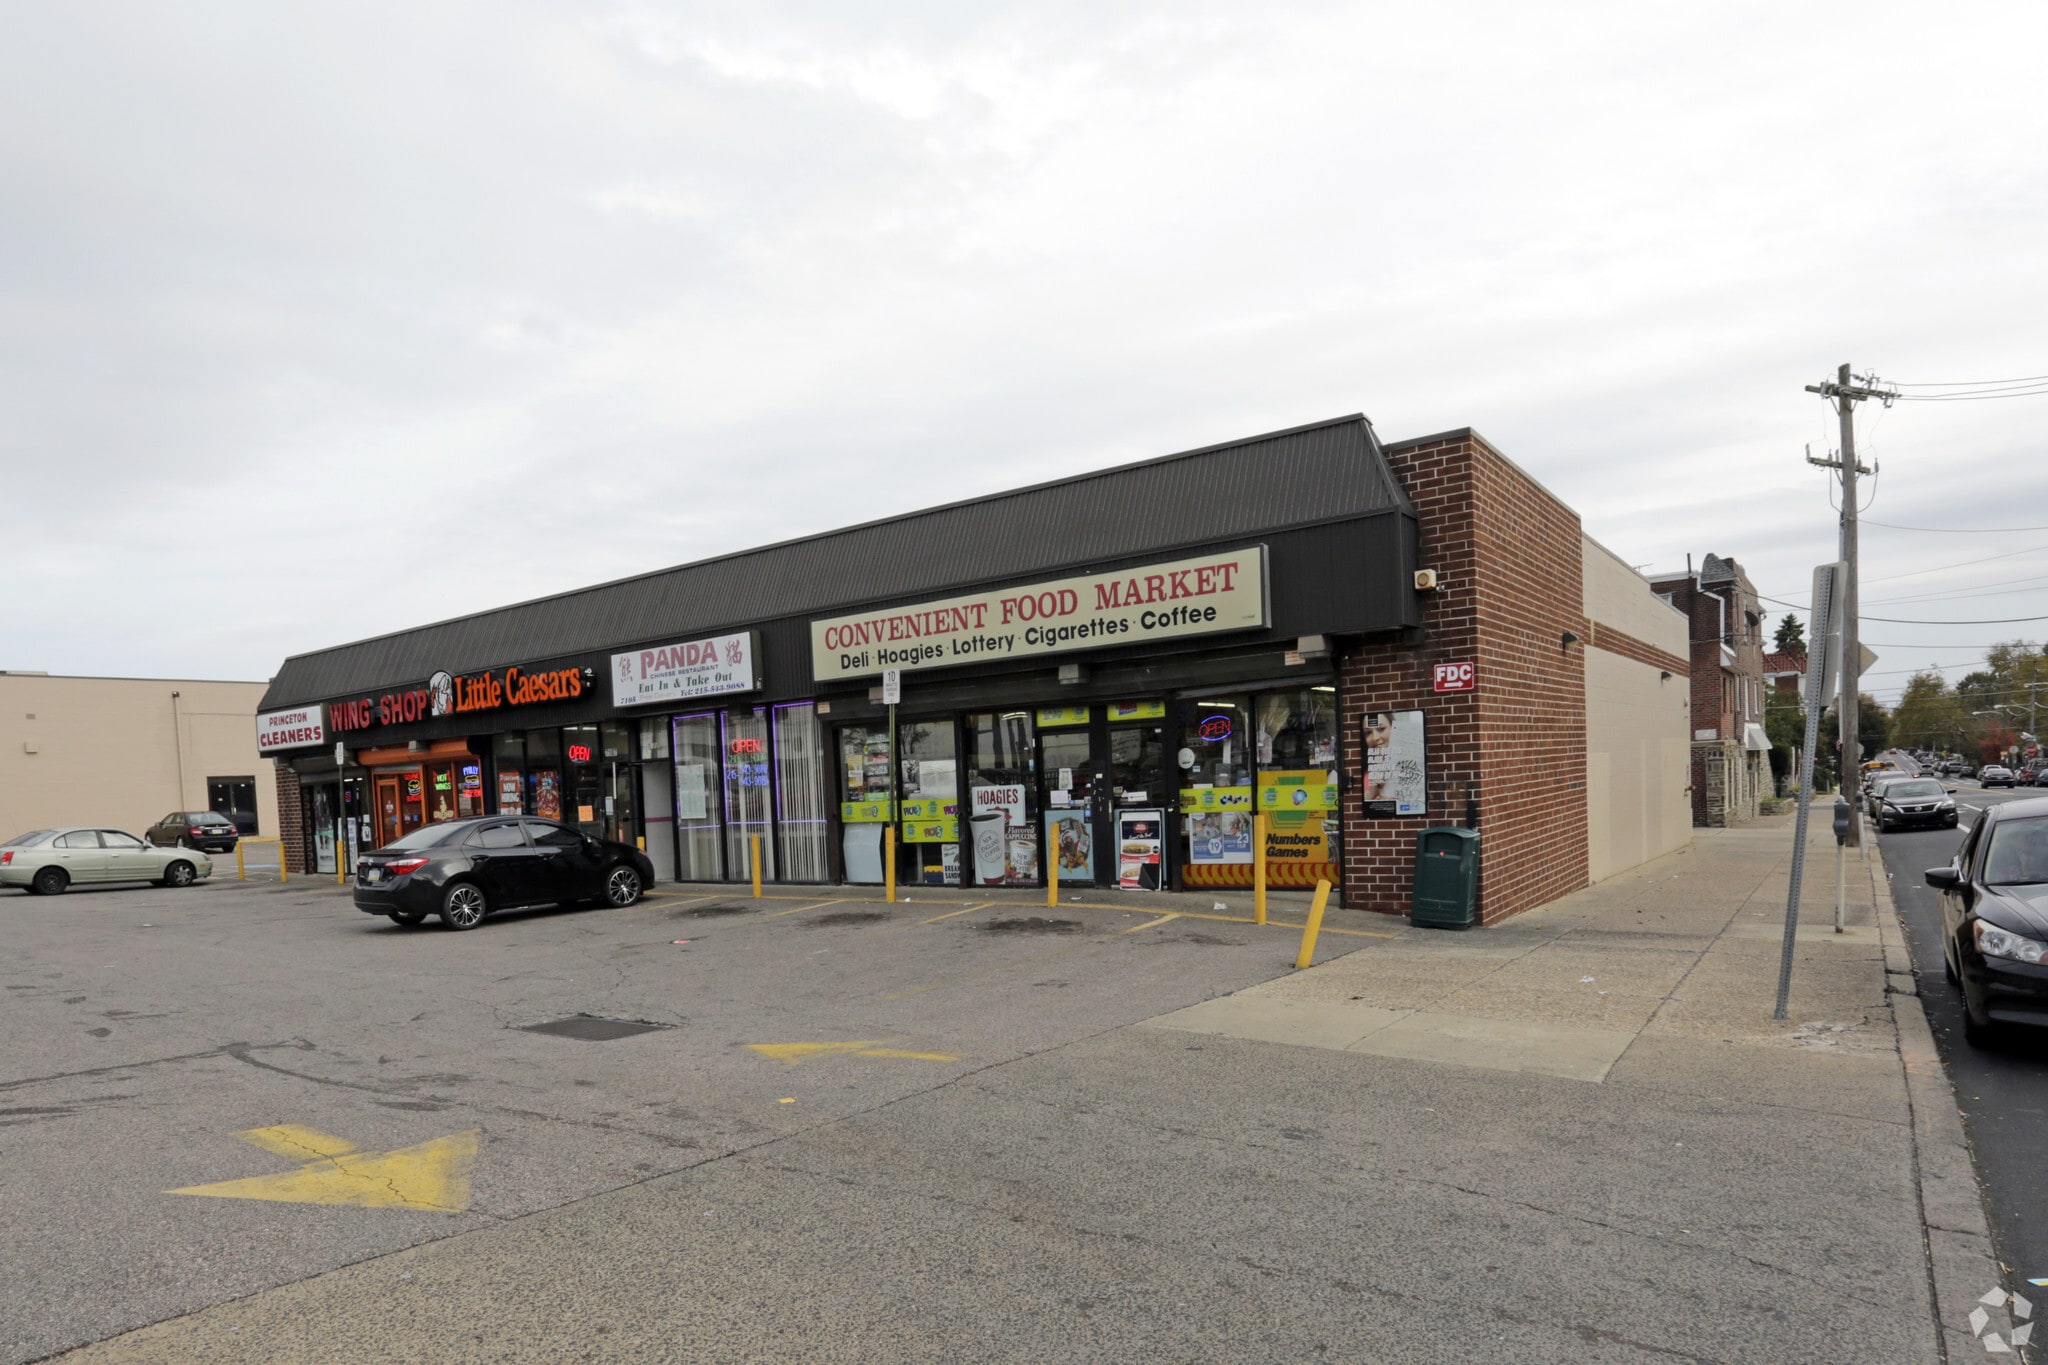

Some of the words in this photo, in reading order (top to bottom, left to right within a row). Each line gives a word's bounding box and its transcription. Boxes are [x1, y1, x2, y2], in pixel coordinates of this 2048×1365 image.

[825, 603, 988, 650] CONVENIENT
[1000, 589, 1078, 624] FOOD
[1094, 562, 1238, 610] MARKET
[840, 652, 869, 669] Deli
[877, 644, 943, 665] Hoagies
[953, 634, 1014, 655] Lottery
[1025, 618, 1129, 646] Cigarettes
[1140, 605, 1217, 629] Coffee
[640, 641, 718, 680] PANDA
[650, 670, 676, 680] CHINESE
[678, 664, 719, 675] RESTAURANT
[887, 670, 896, 682] 10
[1436, 664, 1472, 682] FDC
[454, 671, 502, 712] Little
[505, 667, 581, 705] Caesars
[639, 682, 654, 693] Eat
[659, 681, 669, 690] In
[674, 678, 681, 688] &
[686, 675, 710, 687] Take
[714, 671, 733, 682] Out
[269, 712, 307, 727] PRINCETON
[329, 699, 371, 732] WING
[380, 690, 427, 726] SHOP
[1198, 719, 1231, 736] OPEN
[260, 726, 322, 747] CLEANERS
[568, 745, 591, 761] OPEN
[731, 739, 762, 753] OPEN
[977, 788, 1019, 805] HOAGIES
[1008, 825, 1035, 834] Flavored
[1237, 833, 1249, 844] 23
[1266, 833, 1321, 845] Numbers
[1266, 846, 1309, 858] Games
